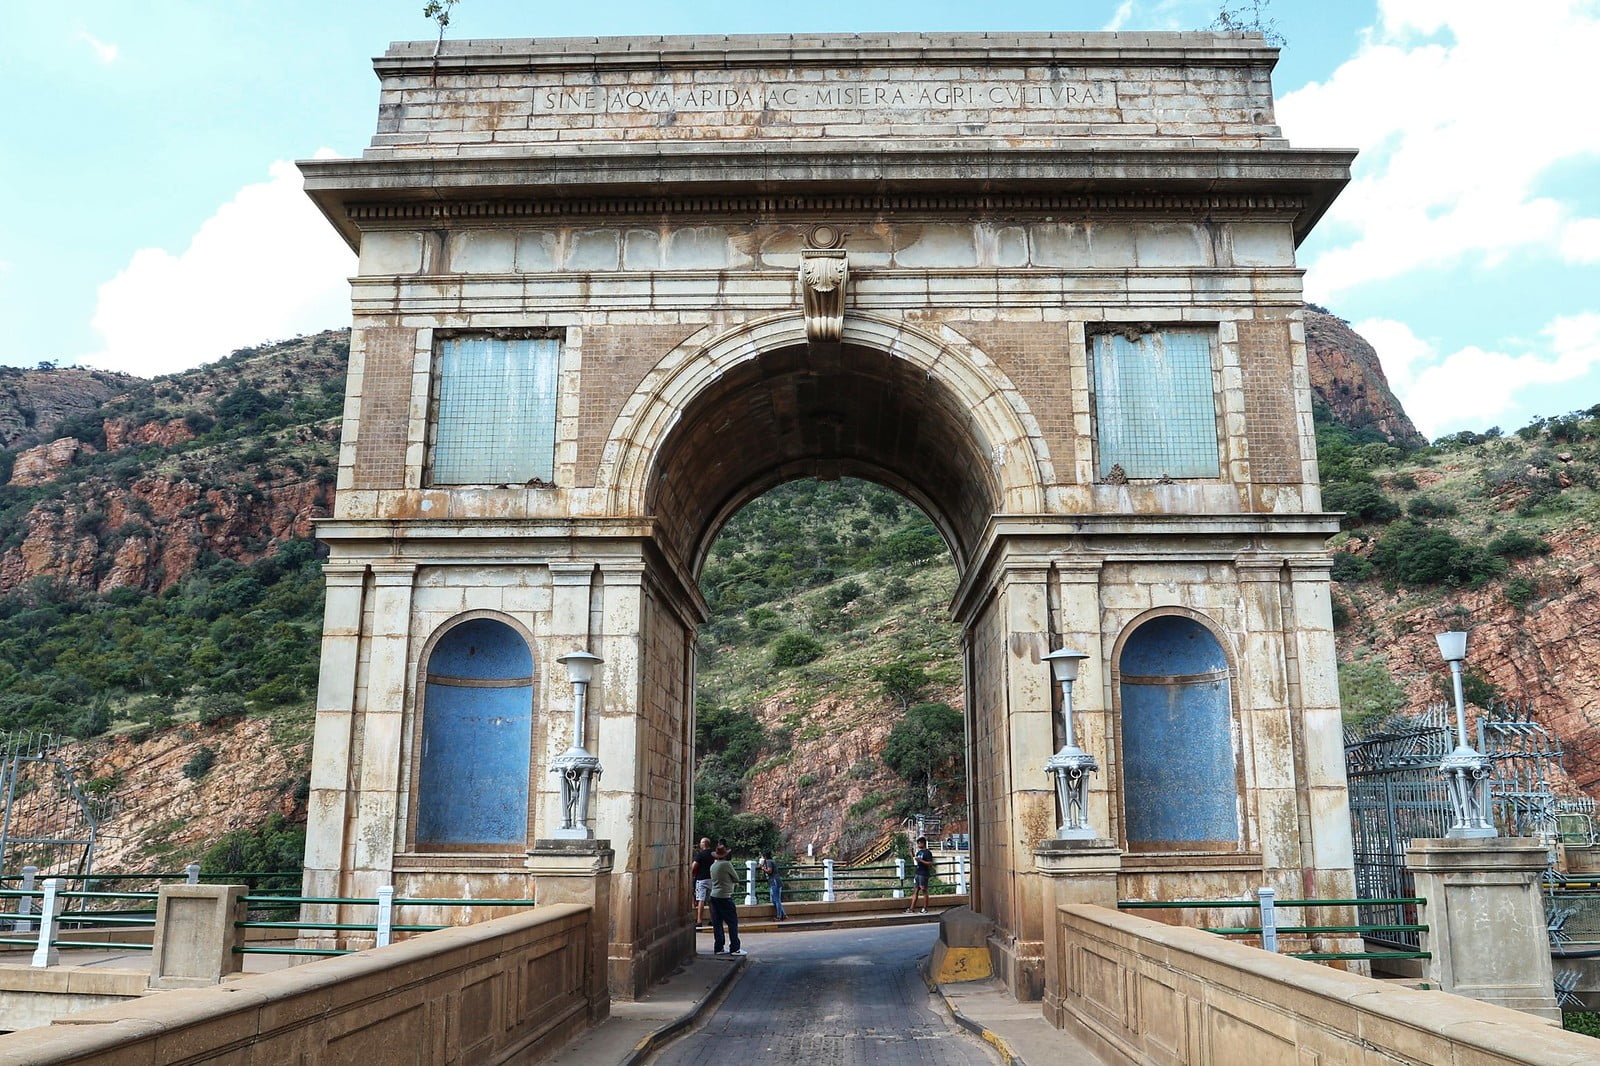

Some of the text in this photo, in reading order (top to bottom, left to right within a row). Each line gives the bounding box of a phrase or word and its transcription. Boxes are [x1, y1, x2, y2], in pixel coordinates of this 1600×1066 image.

[545, 86, 1096, 111] SINE AQVA ARIDA AC MISERA AGRI CVLTVRA
